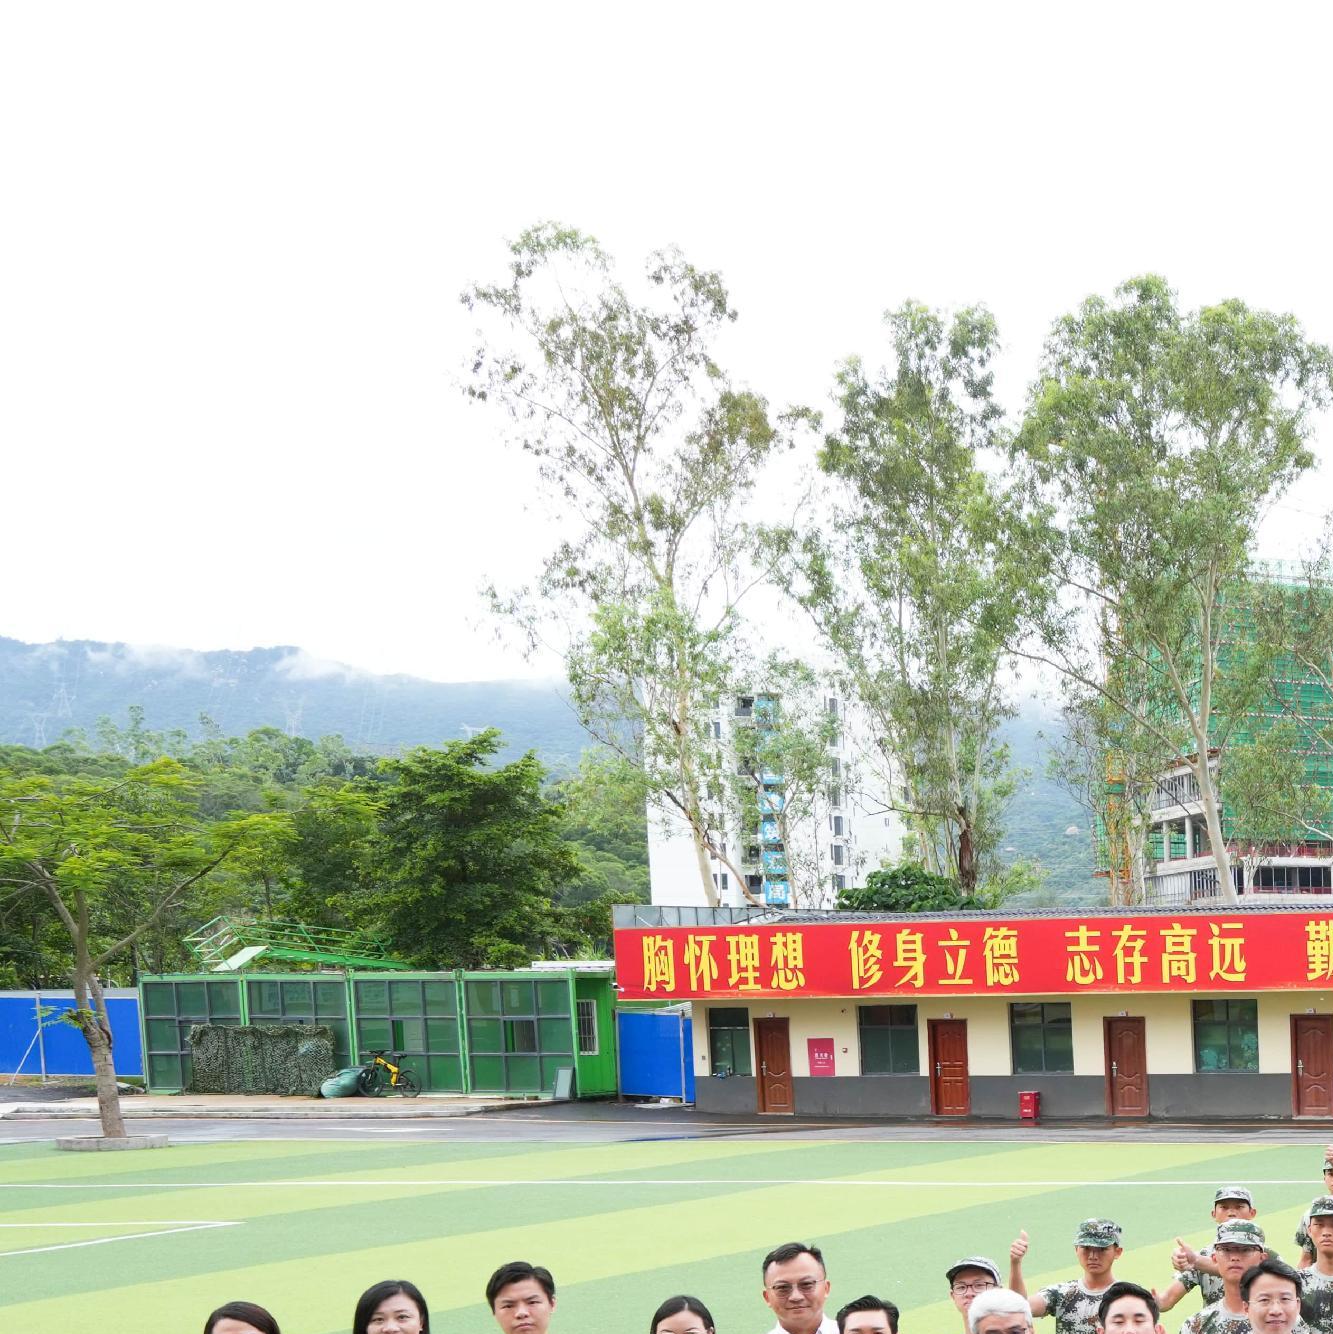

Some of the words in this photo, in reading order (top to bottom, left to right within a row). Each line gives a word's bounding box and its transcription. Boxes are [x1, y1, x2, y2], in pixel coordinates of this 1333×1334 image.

[642, 932, 806, 992] 胸怀理想
[849, 926, 1020, 989] 修身立德
[1066, 922, 1247, 984] 志存高远
